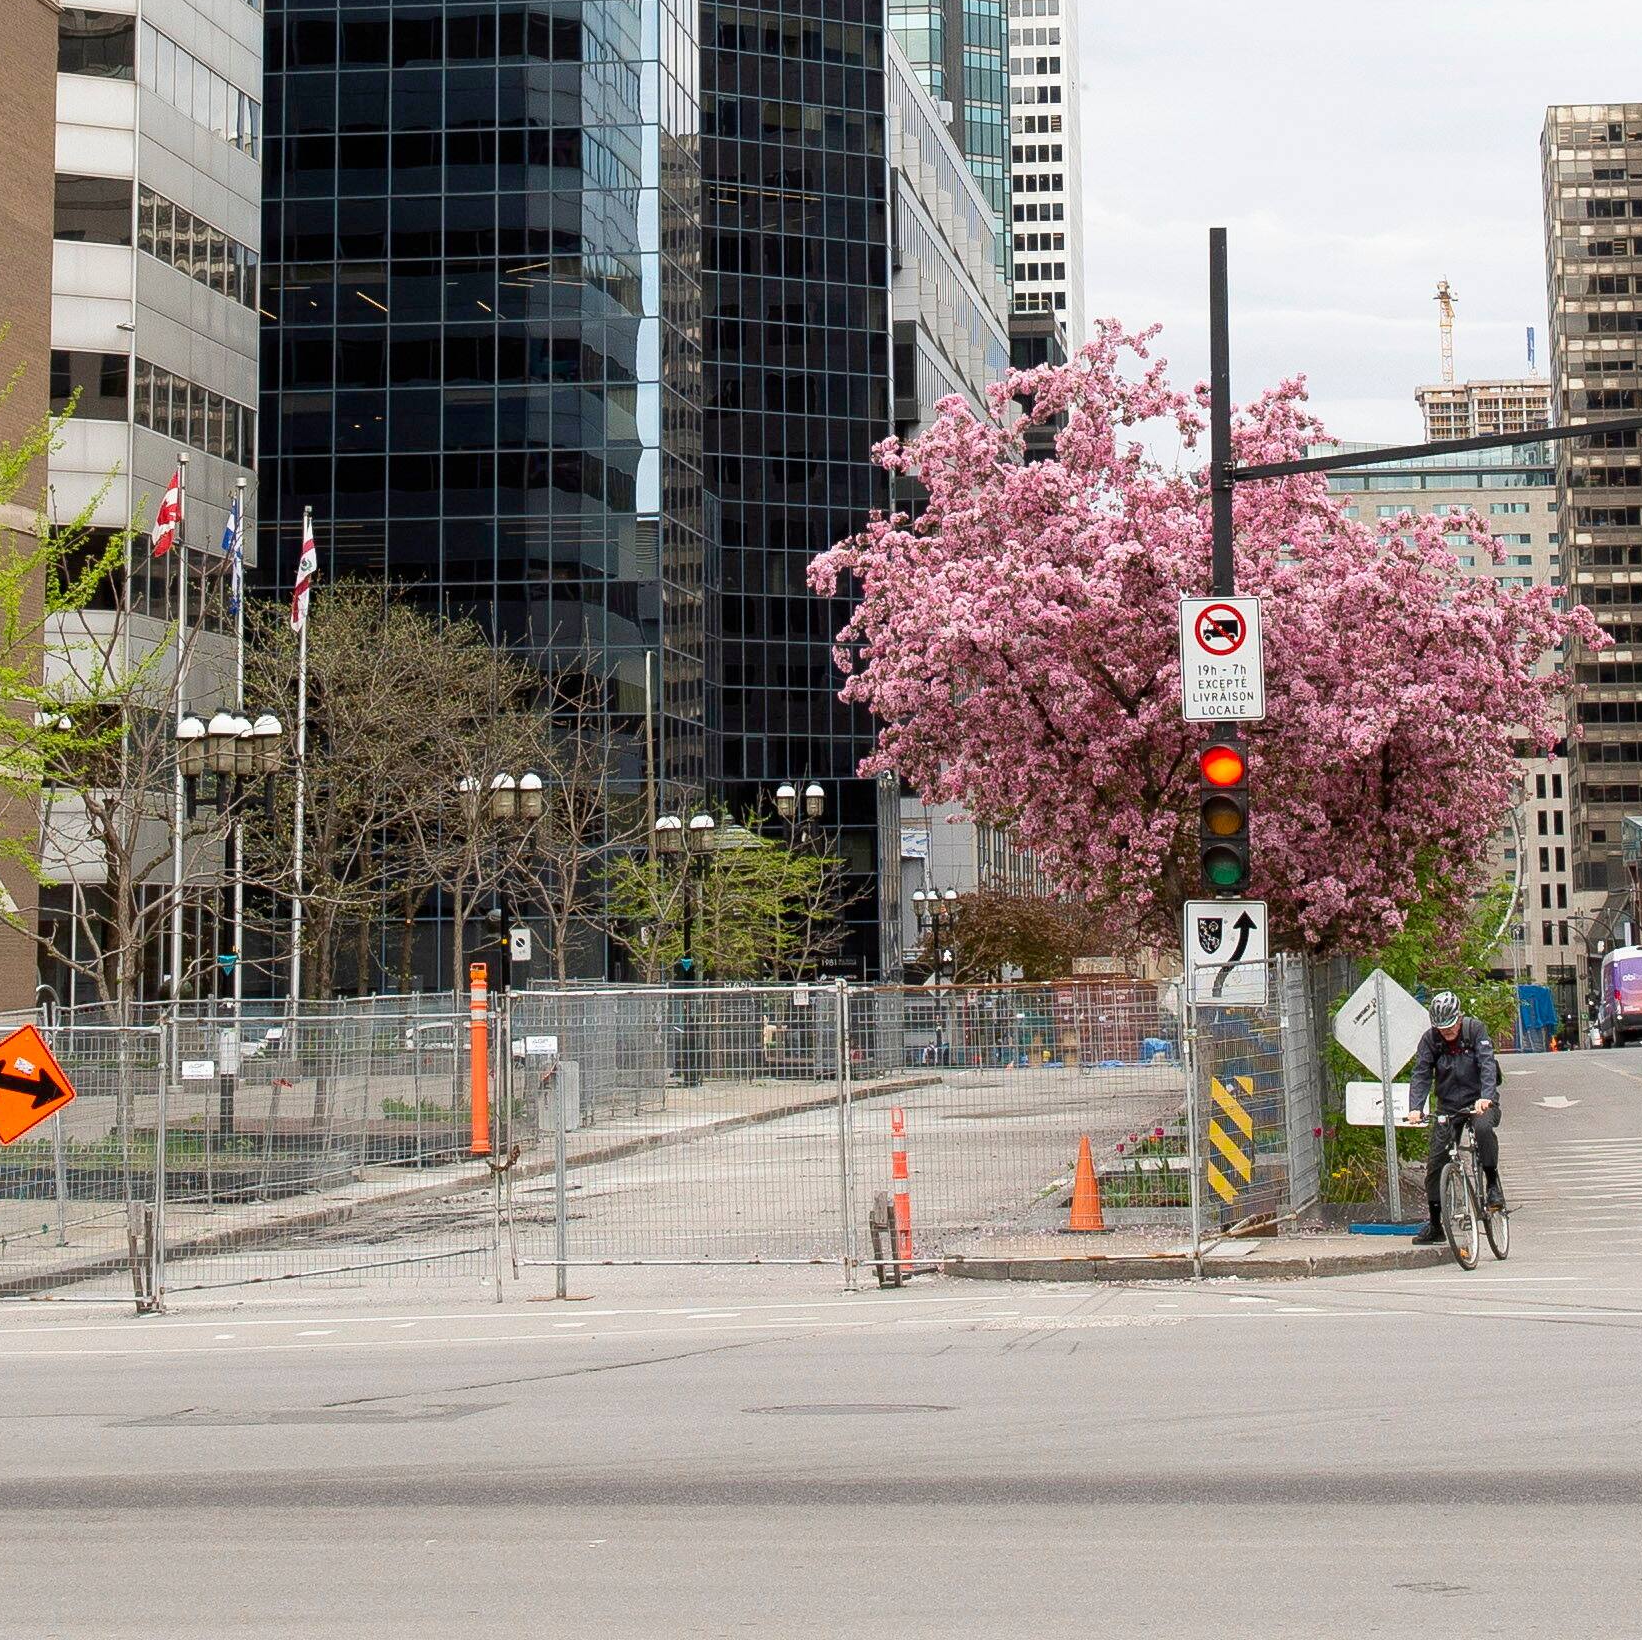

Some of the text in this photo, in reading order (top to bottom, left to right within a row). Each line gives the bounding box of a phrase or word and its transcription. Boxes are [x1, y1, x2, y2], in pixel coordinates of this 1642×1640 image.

[1197, 664, 1217, 676] 19h
[1232, 664, 1247, 675] 7h
[1198, 676, 1247, 689] EXCEPTÉ
[1193, 691, 1254, 702] LIVRAISON
[1202, 705, 1247, 715] LOCALE
[821, 958, 838, 967] 1981
